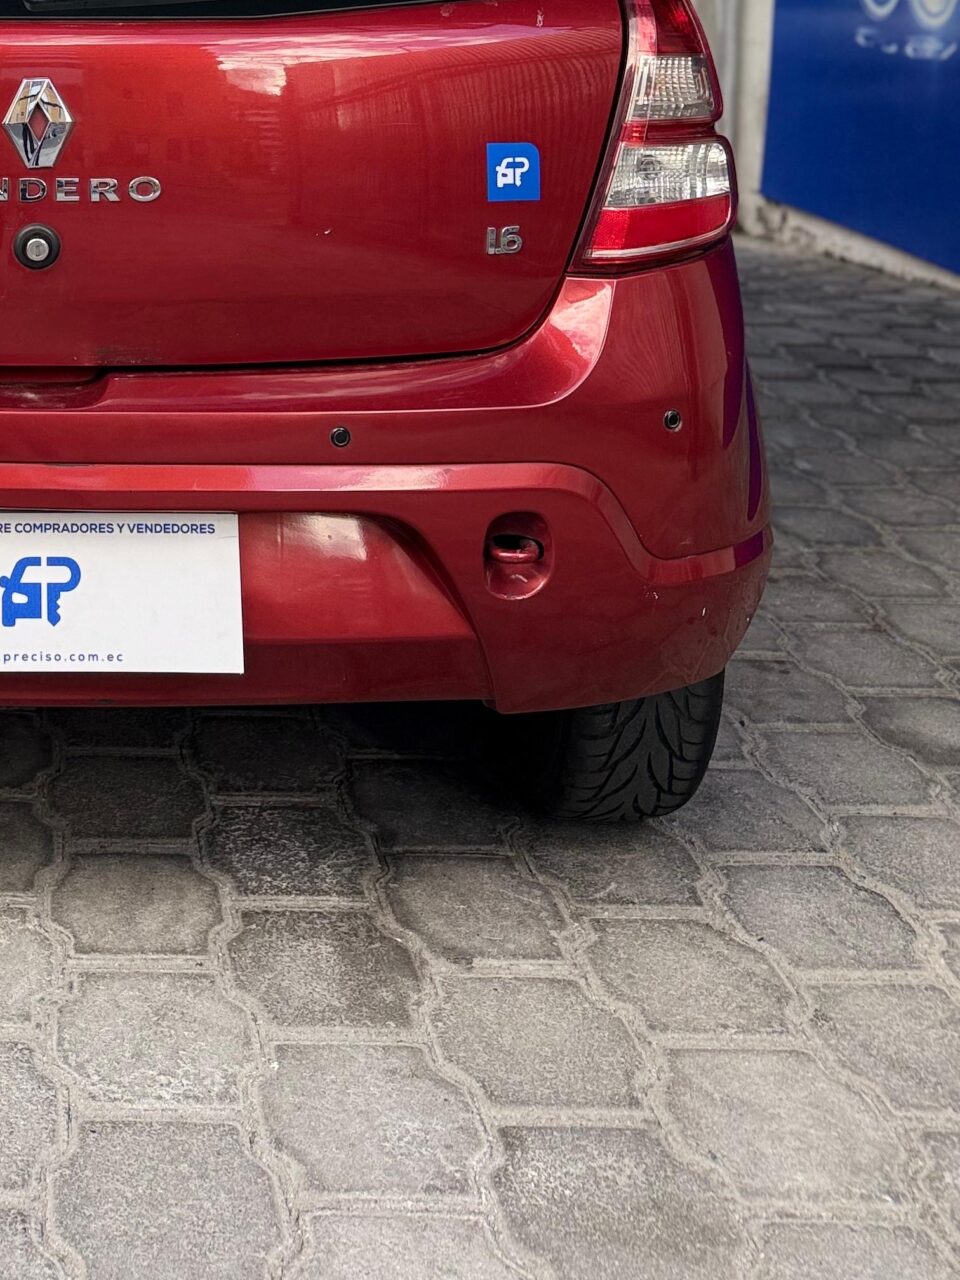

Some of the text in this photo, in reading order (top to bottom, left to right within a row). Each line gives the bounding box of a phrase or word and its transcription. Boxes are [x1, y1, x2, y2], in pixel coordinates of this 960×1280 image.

[14, 523, 115, 534] COMPRADORES
[117, 523, 125, 534] Y
[127, 523, 216, 535] VENDEDORES
